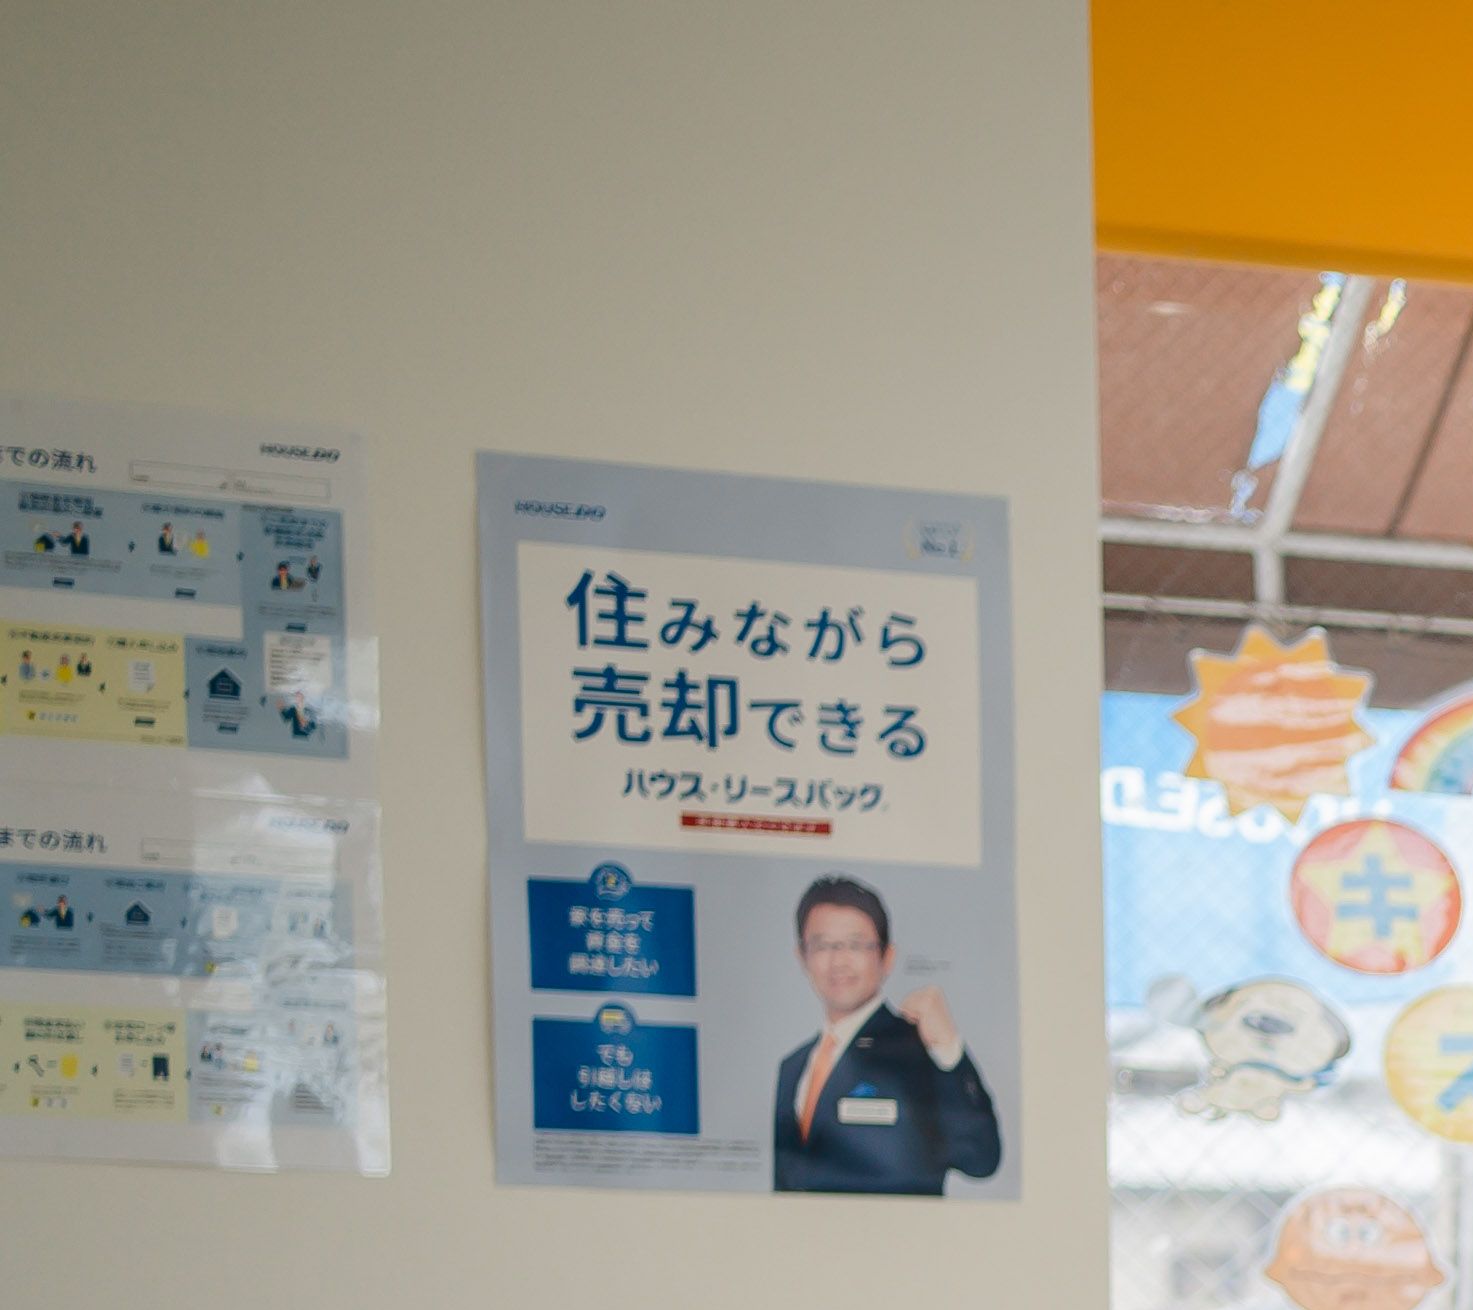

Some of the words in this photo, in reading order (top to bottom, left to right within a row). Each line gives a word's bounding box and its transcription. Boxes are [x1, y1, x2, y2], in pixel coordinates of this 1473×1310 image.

[0, 444, 97, 474] での流れ
[564, 568, 927, 668] 住みながら
[571, 664, 928, 760] 売却できる
[622, 767, 883, 812] ハウス・リースバック
